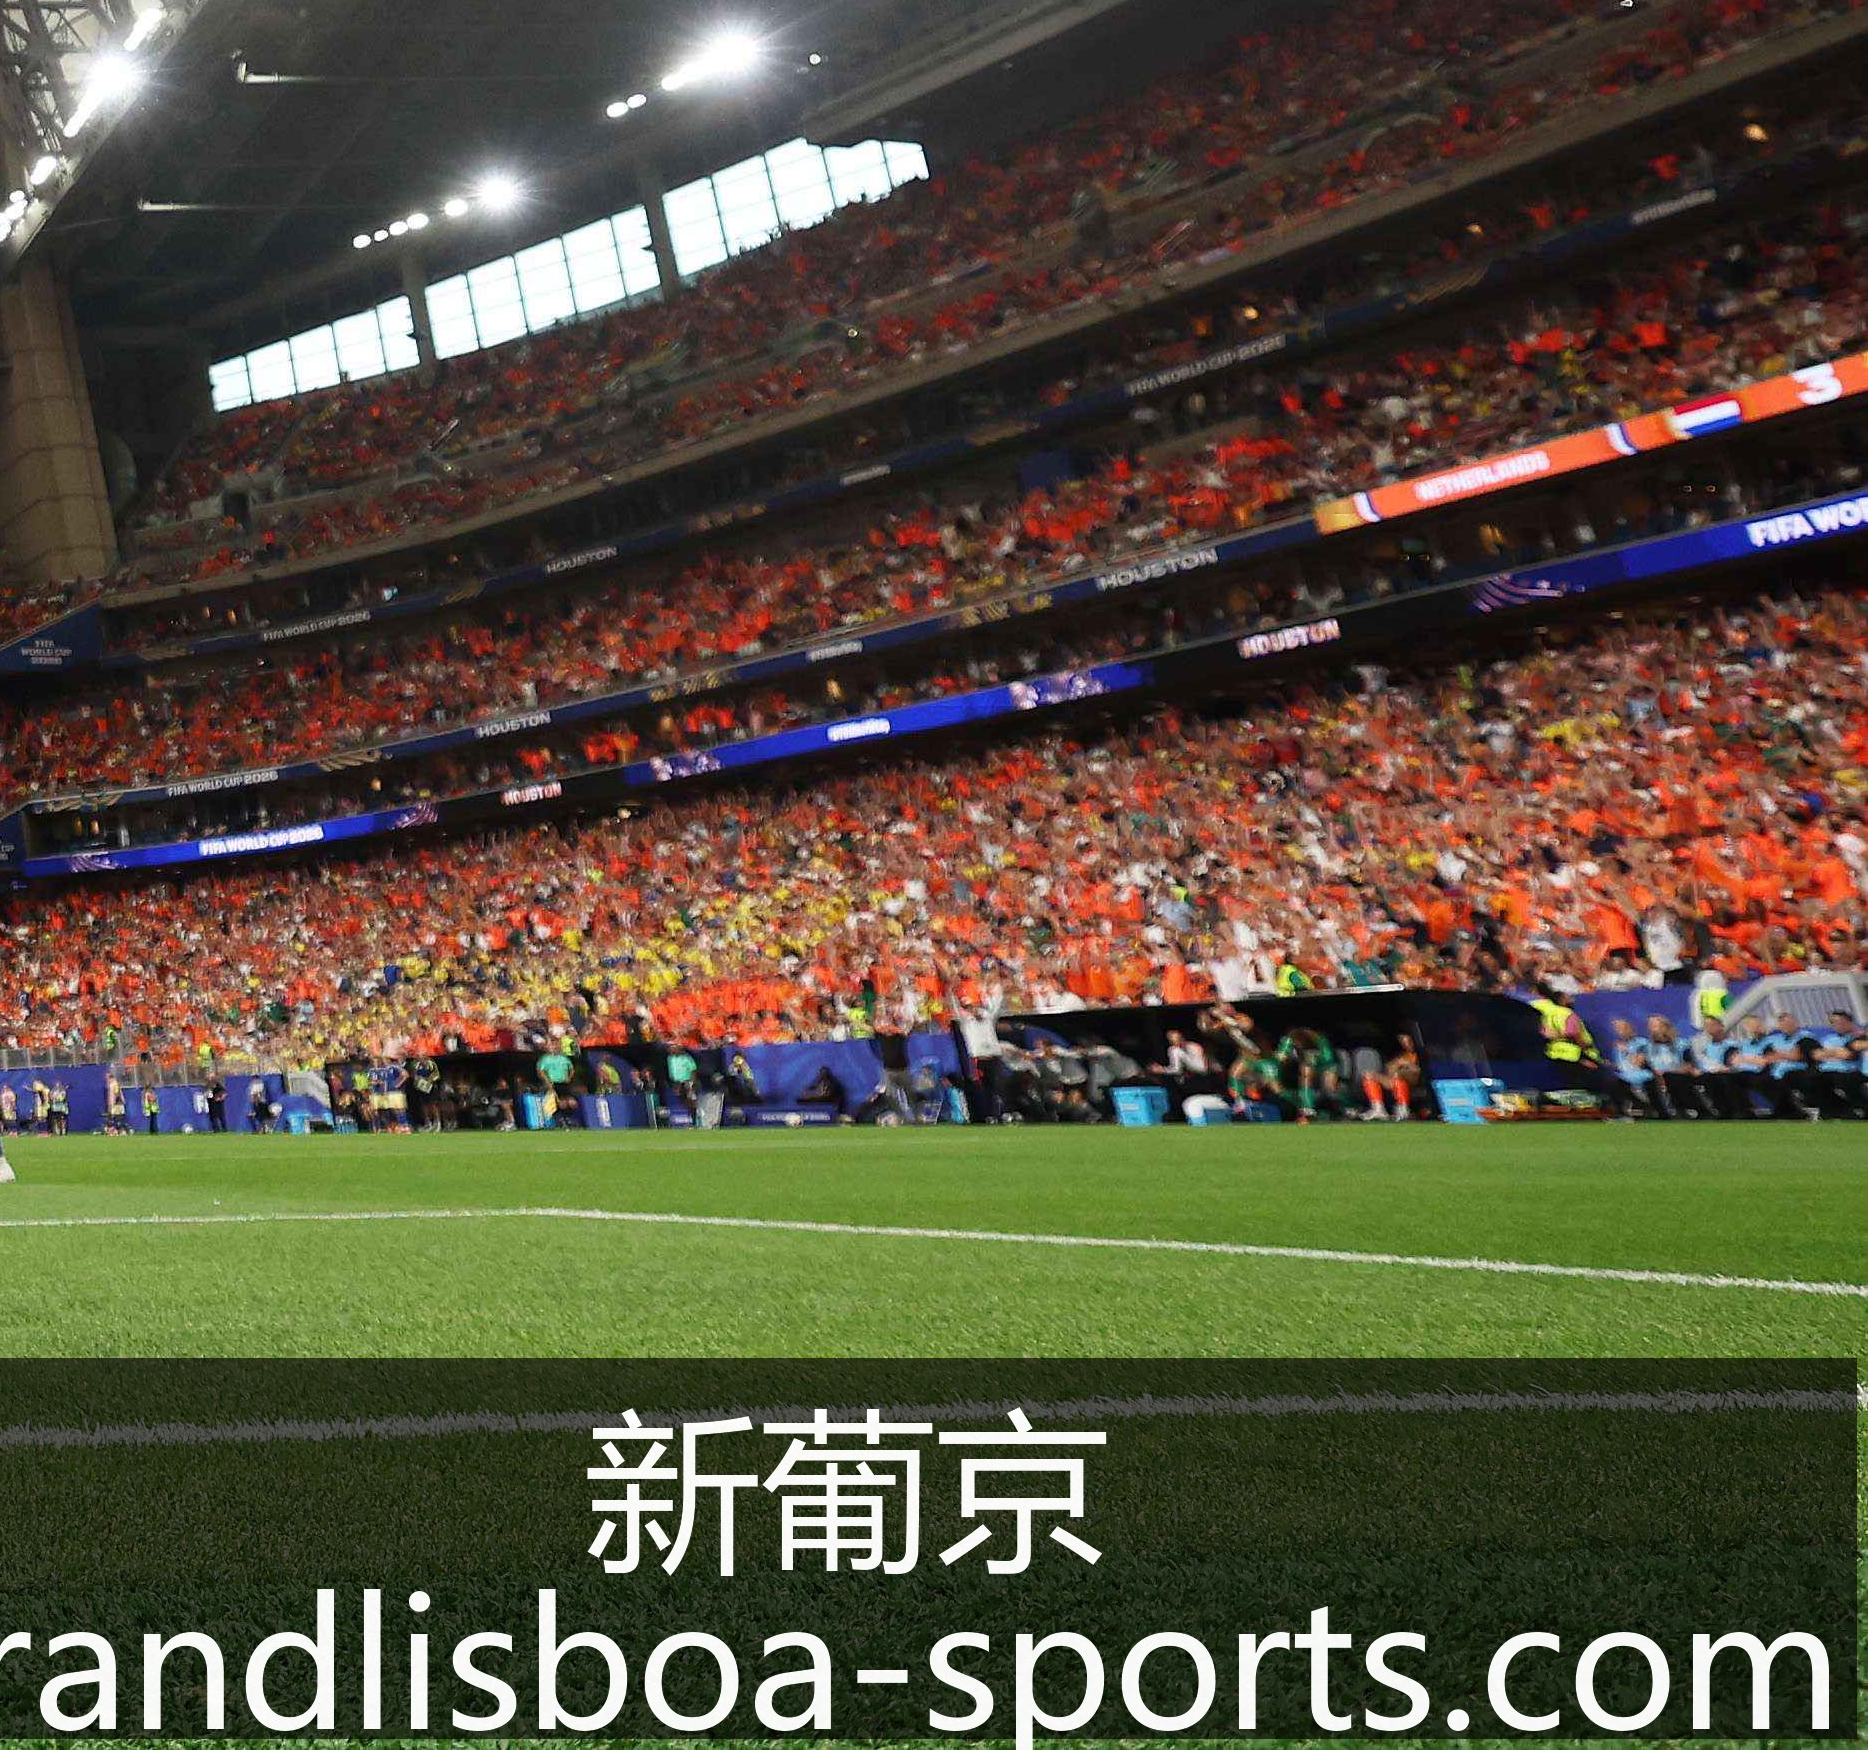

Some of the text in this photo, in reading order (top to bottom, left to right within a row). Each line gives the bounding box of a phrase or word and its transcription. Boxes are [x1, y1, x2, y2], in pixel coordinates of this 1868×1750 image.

[1790, 362, 1843, 405] 3
[1745, 512, 1815, 547] FIFA
[547, 545, 617, 573] HOUSTON
[1096, 548, 1218, 591] HOUSTON
[476, 711, 551, 738] HOUSTON
[168, 769, 279, 796] FIFA WORLD CUP 2026
[501, 781, 563, 806] HOUSTON
[200, 824, 324, 855] FIFA WORLD CUP 2026
